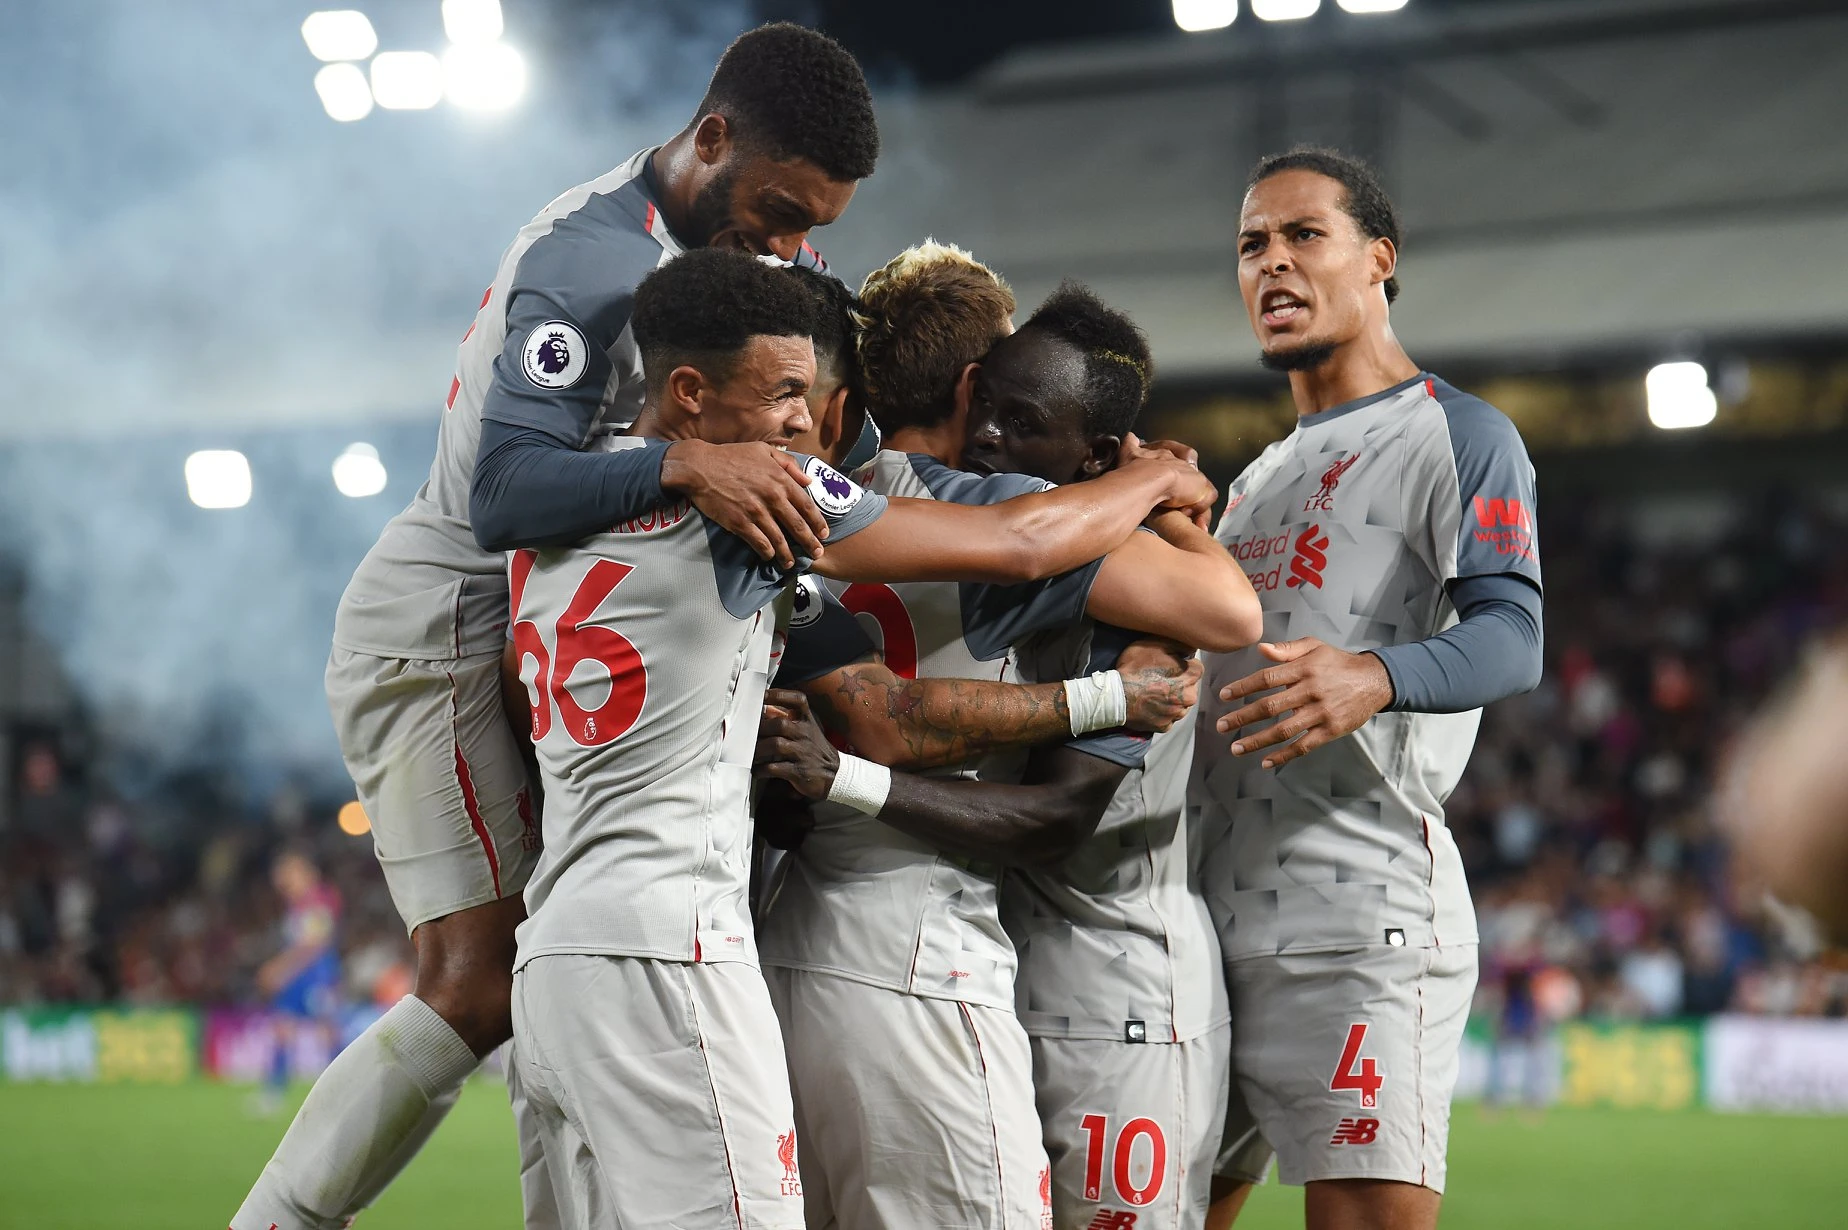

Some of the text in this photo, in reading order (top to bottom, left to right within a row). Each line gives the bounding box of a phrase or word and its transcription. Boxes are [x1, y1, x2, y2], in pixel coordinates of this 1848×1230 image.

[820, 497, 839, 511] Premier
[1329, 1022, 1384, 1110] 4
[1079, 1113, 1167, 1208] 10
